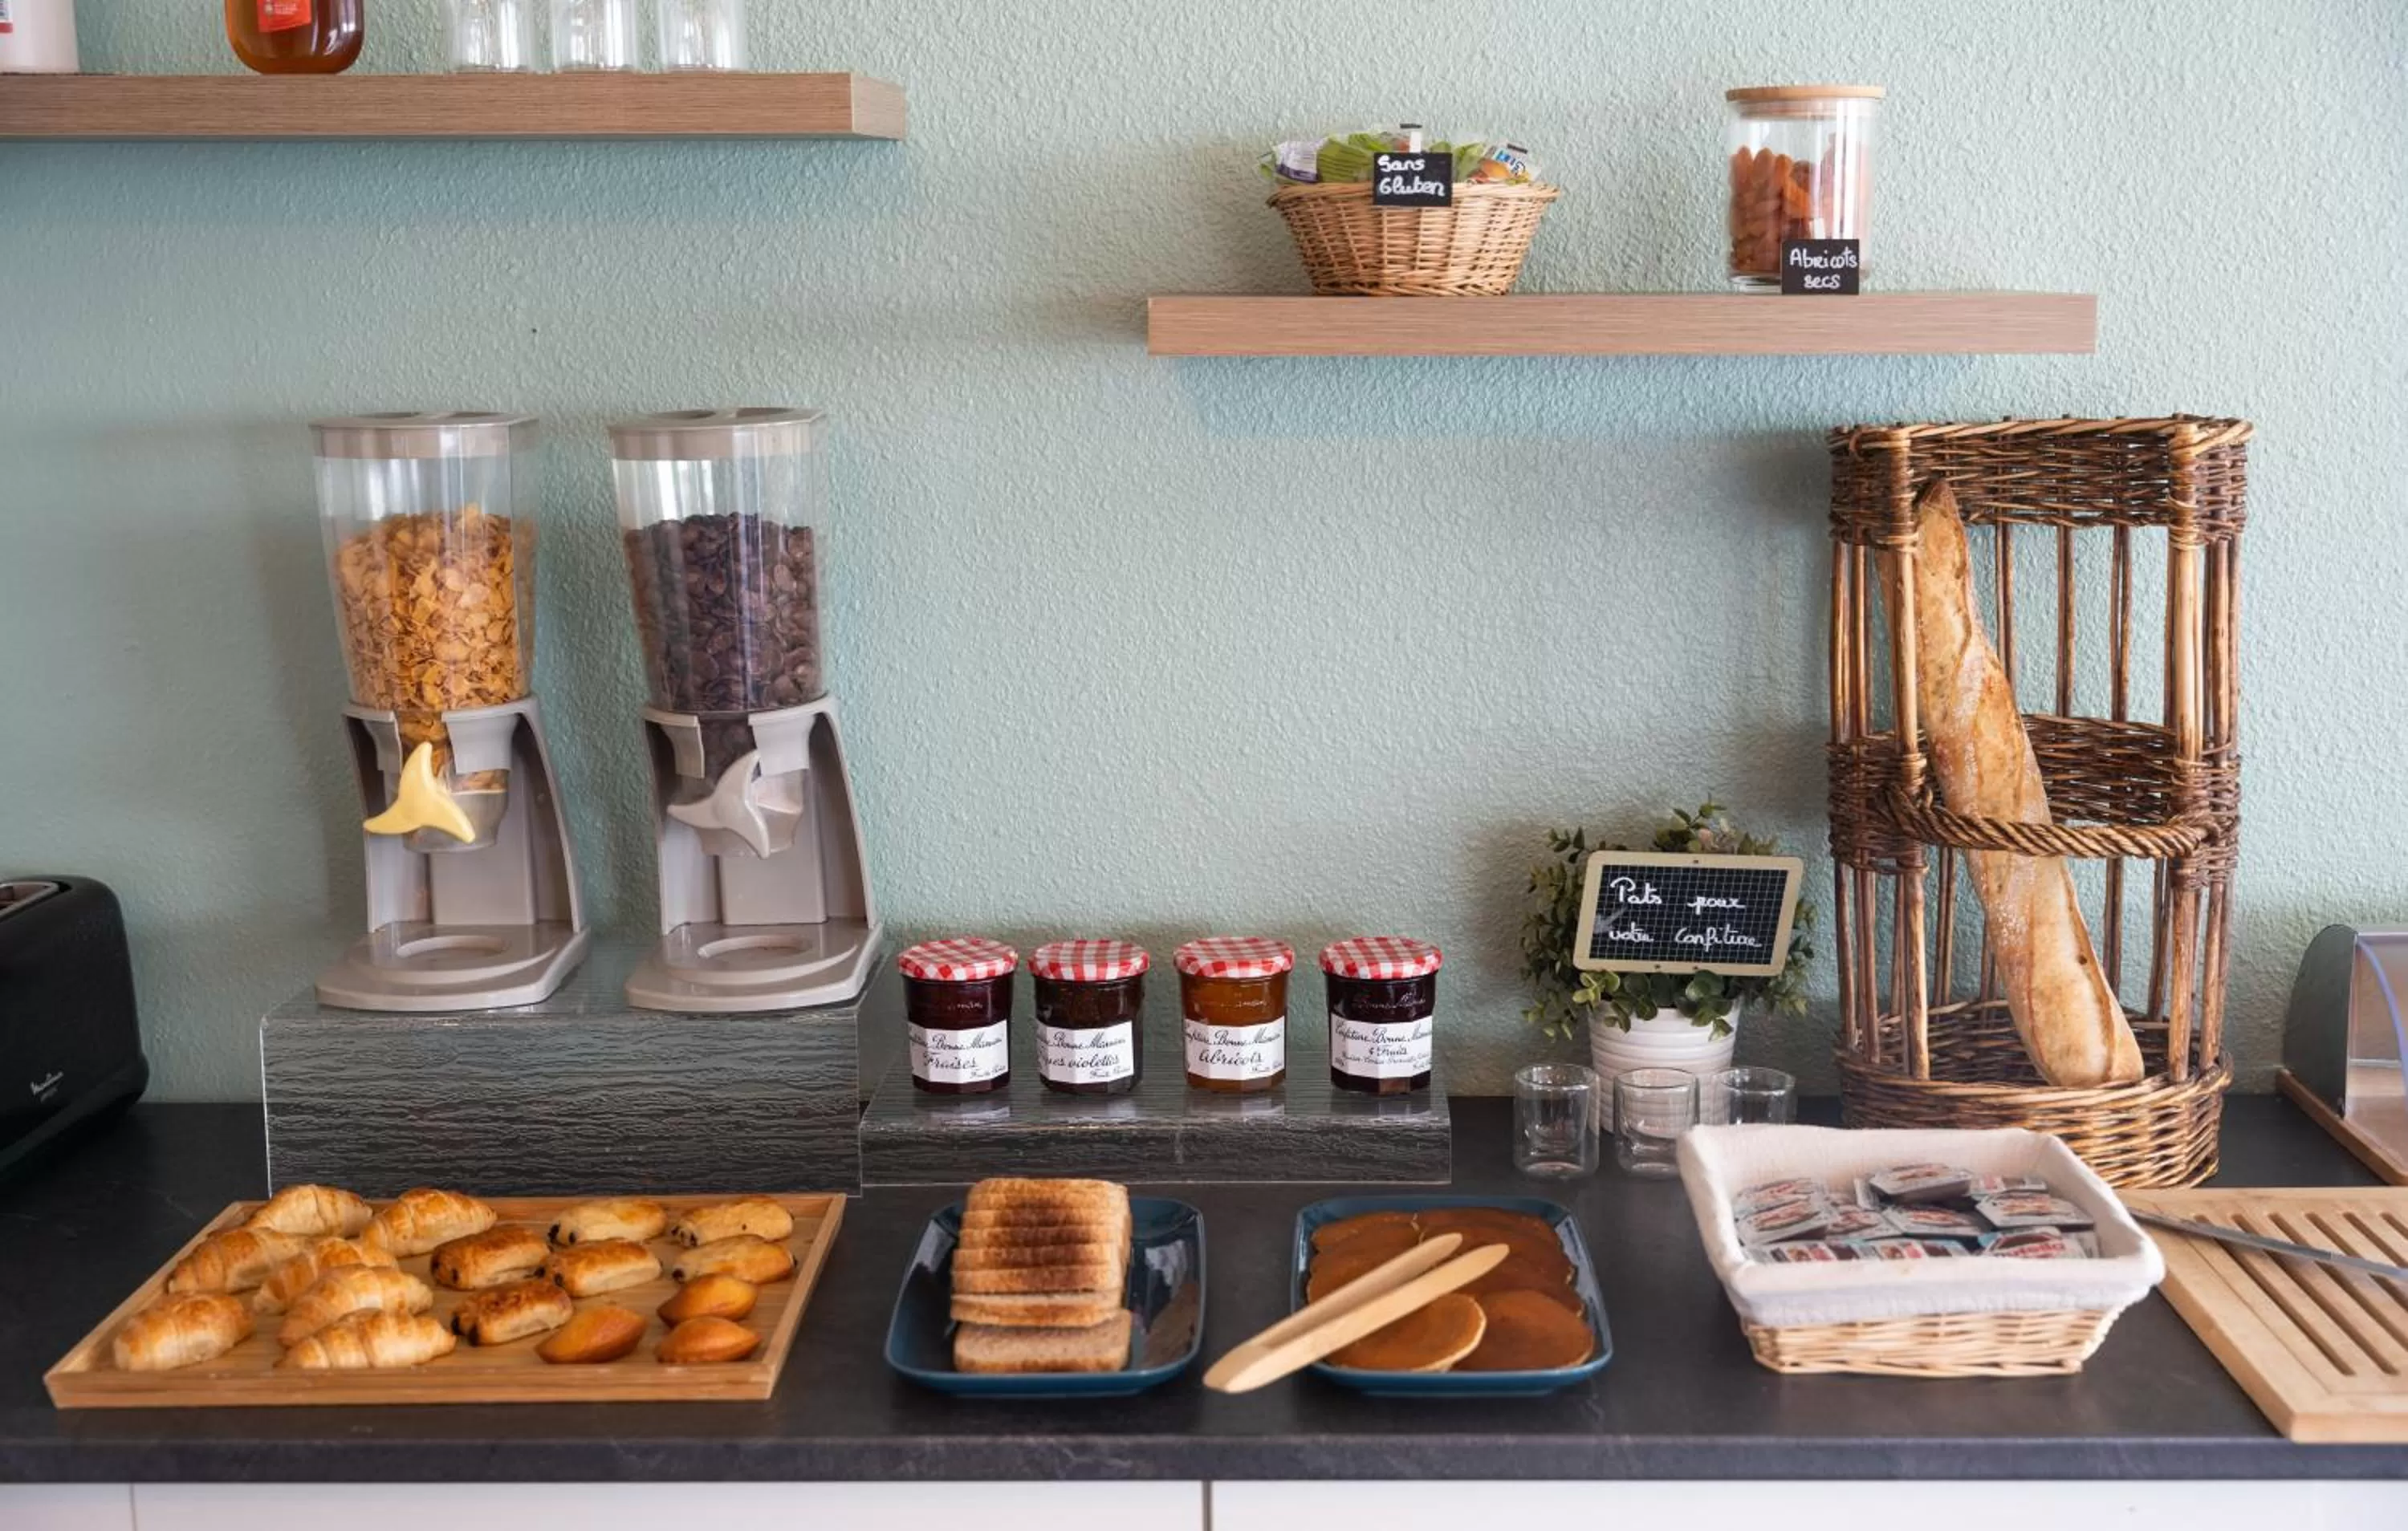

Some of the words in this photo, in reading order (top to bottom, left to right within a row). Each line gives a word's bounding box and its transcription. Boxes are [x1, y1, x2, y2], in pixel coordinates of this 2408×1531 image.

[1377, 154, 1426, 173] Sans
[1379, 175, 1446, 197] Gluten
[1789, 246, 1858, 269] Abricots
[1804, 274, 1841, 290] secs
